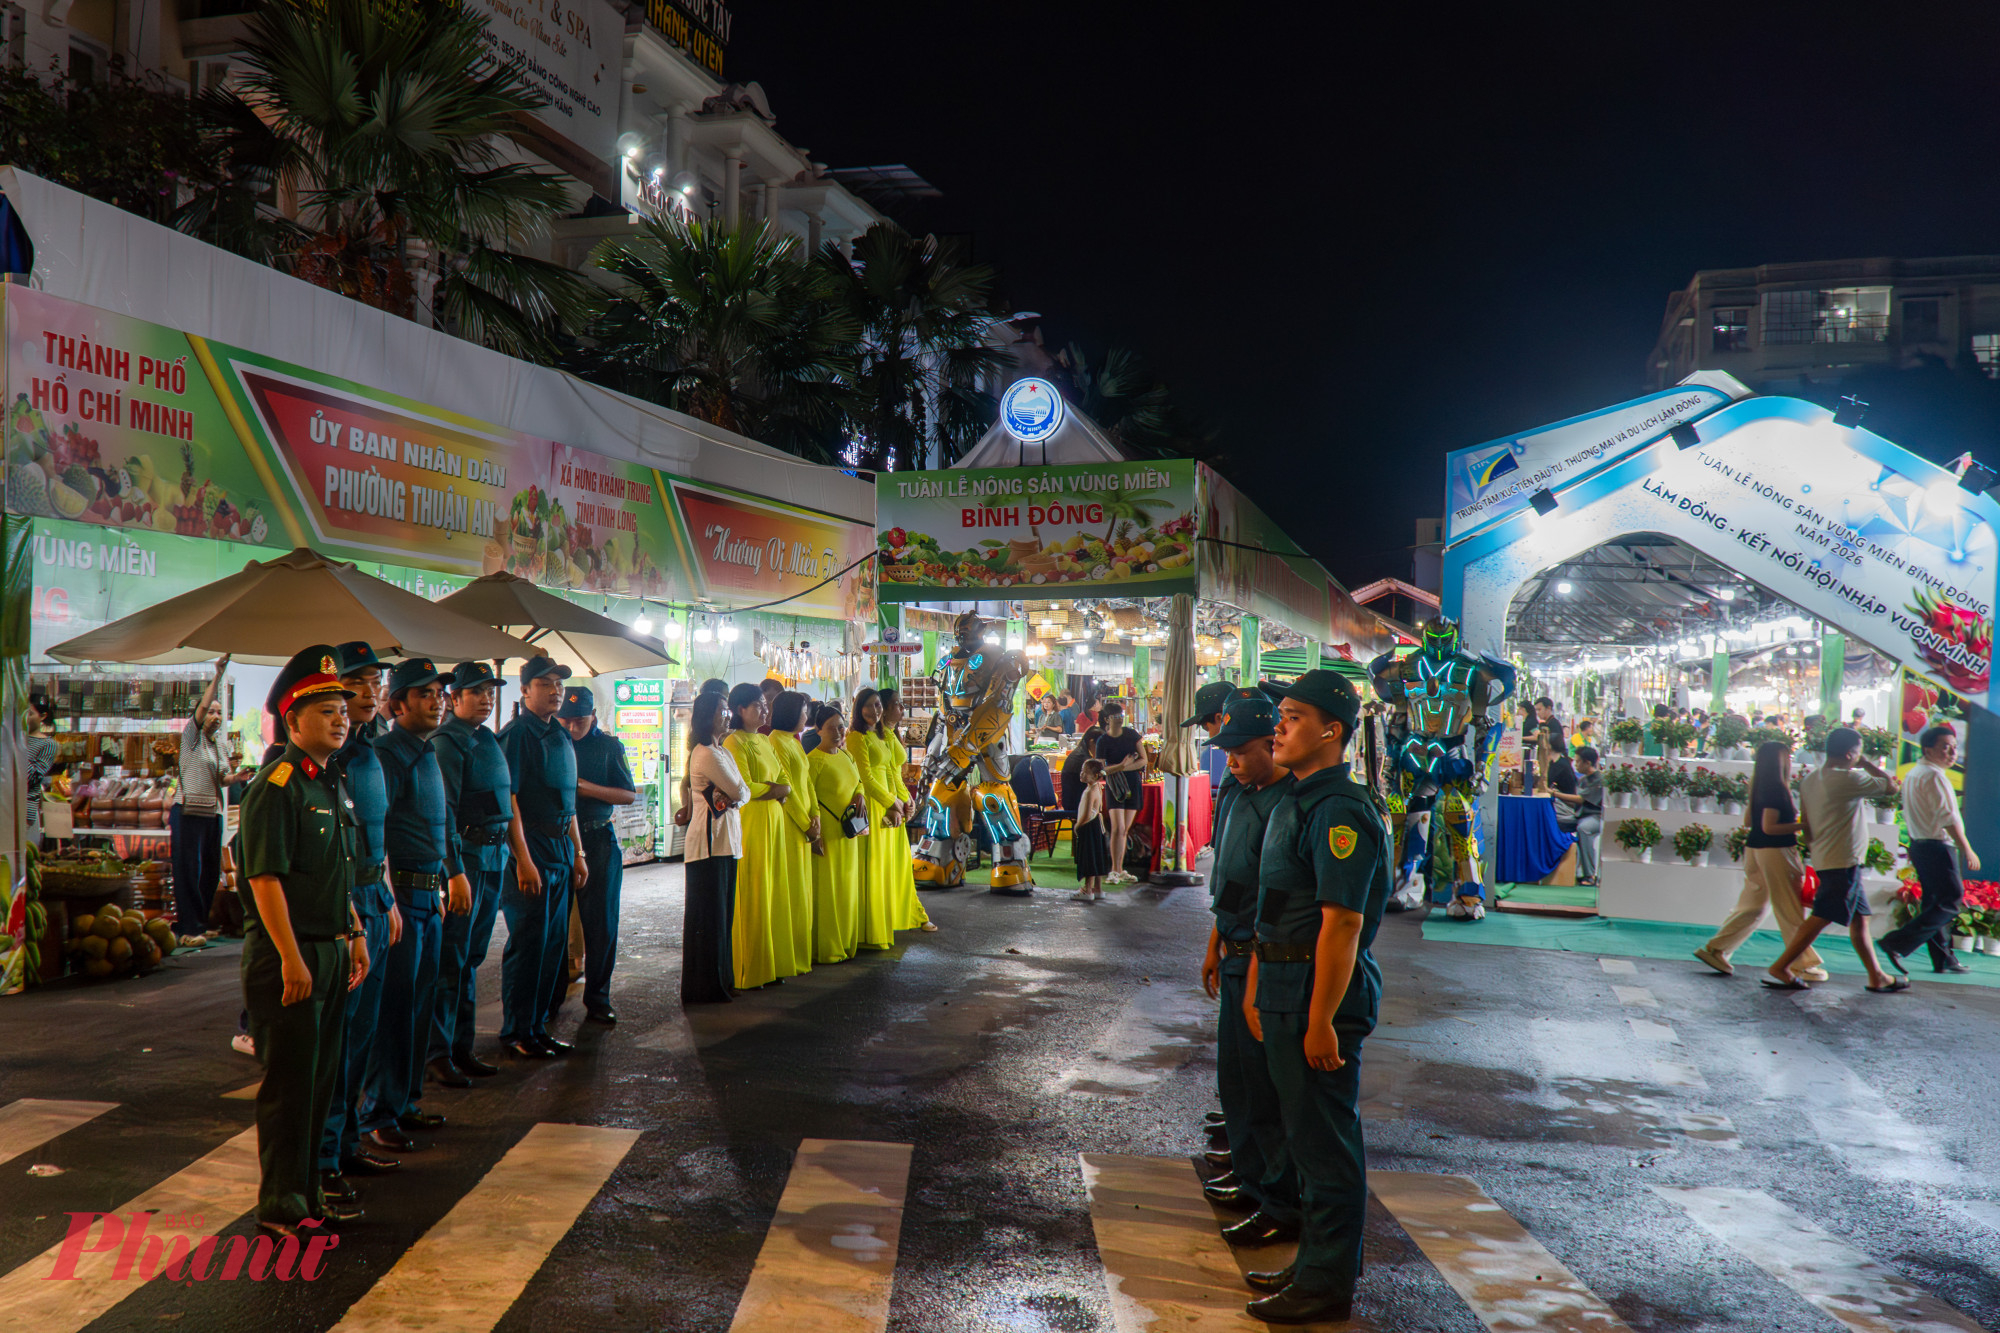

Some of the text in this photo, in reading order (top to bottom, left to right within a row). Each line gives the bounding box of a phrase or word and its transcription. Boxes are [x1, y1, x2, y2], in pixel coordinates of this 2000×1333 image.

[566, 10, 592, 49] SPA
[548, 73, 568, 95] CÔNG
[587, 100, 601, 117] CAO
[43, 330, 189, 396] THÀNH PHỐ
[31, 372, 194, 441] HỒ CHÍ MINH
[309, 410, 506, 488] ỦY BAN NHÂN DÂN
[1455, 502, 1483, 520] TRUNG
[1482, 494, 1501, 508] TÂM
[1564, 445, 1600, 468] THƯƠNG
[1615, 430, 1628, 444] VÀ
[1626, 425, 1641, 438] DU
[1657, 408, 1677, 424] LÂM
[324, 465, 496, 539] PHƯỜNG THUẬN AN
[560, 461, 572, 487] XÃ
[574, 467, 598, 493] HƯNG
[598, 472, 626, 499] KHÁNH
[897, 466, 1171, 498] TUẦN LỄ NÔNG SẢN VÙNG MIỀN
[576, 495, 637, 532] TỈNH VĨNH LONG
[961, 501, 1103, 528] BÌNH ĐÔNG
[1697, 451, 1990, 616] TUẦN LỄ NÔNG SẢN VÙNG MIỀN BÌNH ĐÔNG
[100, 538, 157, 577] MIỀN
[766, 537, 786, 582] Vị
[785, 541, 819, 578] Miền
[1795, 523, 1865, 566] NĂM 2026
[1641, 477, 1678, 504] LÂM
[1678, 497, 1728, 530] ĐỒNG
[1737, 529, 1772, 552] KẾT
[1770, 547, 1804, 572] NỐI
[1803, 565, 1838, 589] HỘI
[1837, 583, 1887, 615] NHẬP
[1890, 611, 1939, 647] VƯƠN
[1937, 644, 1989, 675] MÌNH
